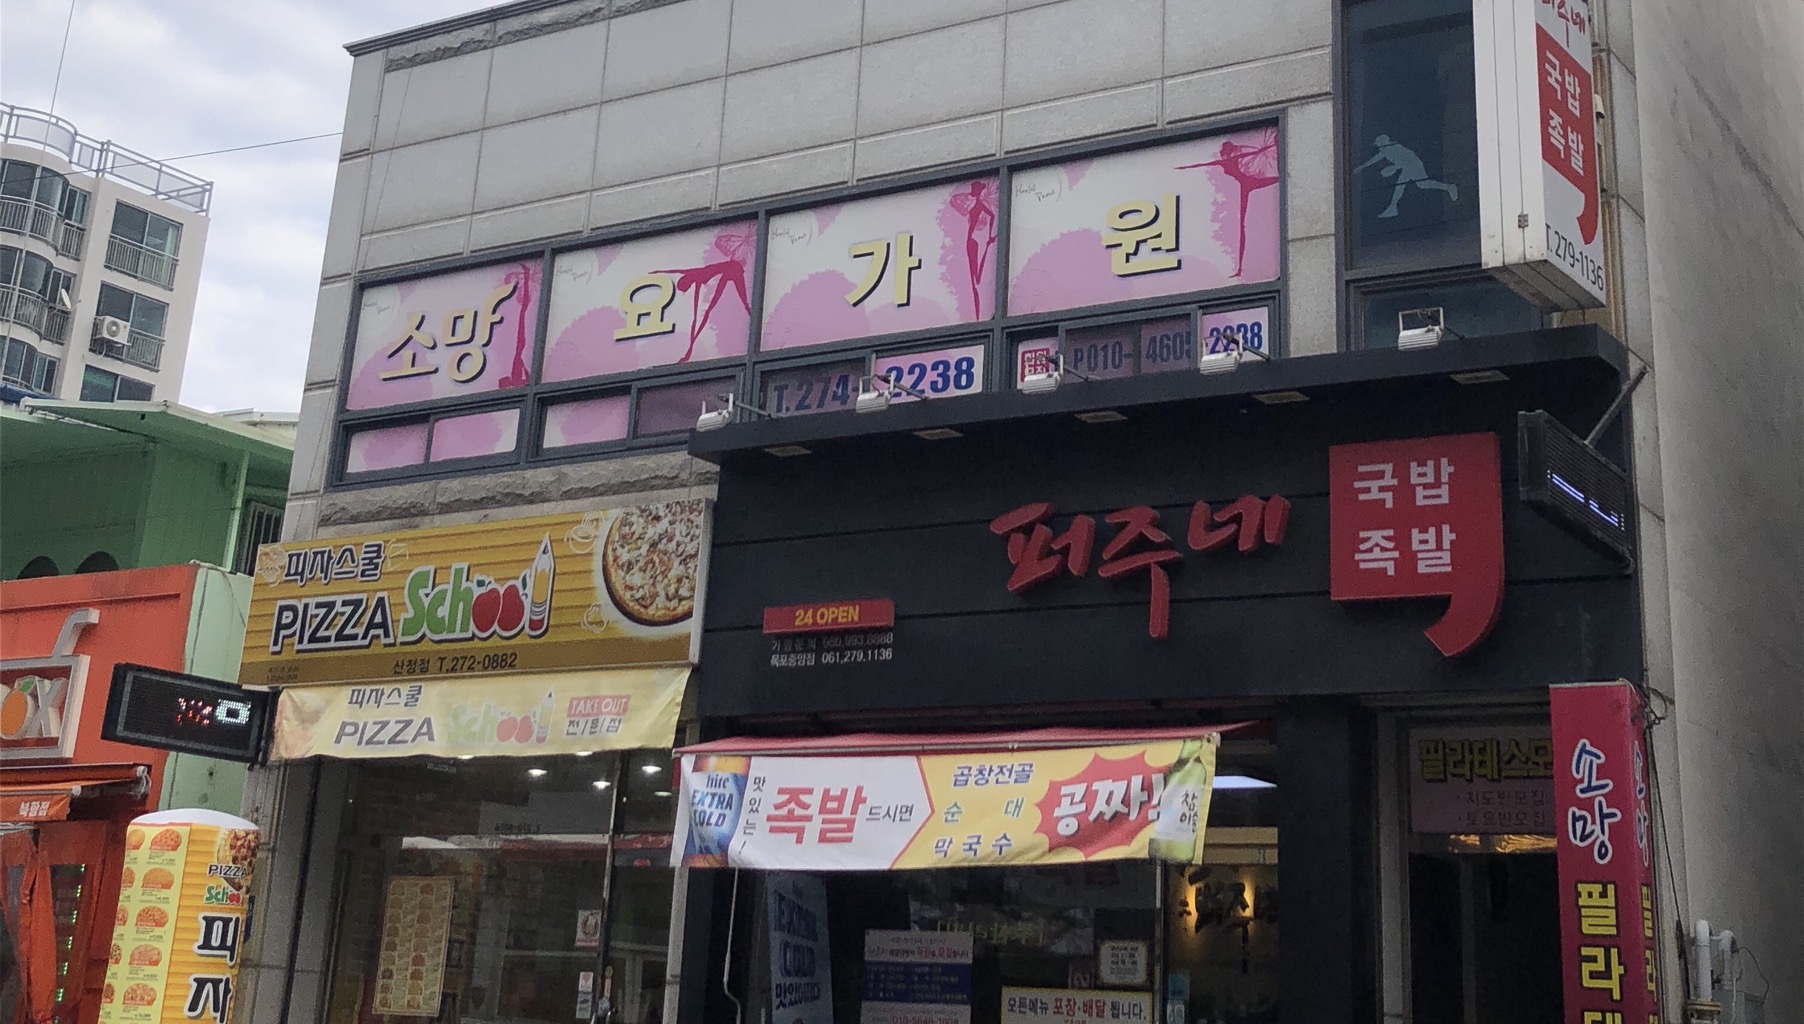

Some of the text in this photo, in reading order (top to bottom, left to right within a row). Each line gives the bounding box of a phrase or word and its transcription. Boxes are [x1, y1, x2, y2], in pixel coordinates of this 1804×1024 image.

[1545, 49, 1582, 117] 국밥
[1547, 108, 1584, 175] 족발
[1545, 222, 1604, 292] T.279-1136
[379, 192, 1183, 384] 소망 요 가 원
[1352, 456, 1456, 508] 국밥
[283, 541, 385, 586] 피자스쿨
[989, 493, 1292, 640] 퍼주네
[1353, 523, 1458, 576] 족발
[270, 534, 556, 655] PIZZA School
[794, 605, 860, 626] 24 OPEN
[392, 652, 519, 675] 산정점 T.272-0882
[333, 690, 556, 746] PIZZA School
[347, 684, 424, 710] 피자스쿨
[571, 697, 628, 715] TAKE OUT
[705, 773, 731, 789] hite
[952, 762, 1035, 788] 곱창전골
[1418, 737, 1554, 783] 필라테스모
[691, 790, 734, 811] EXTRA
[693, 810, 727, 828] COLD
[765, 784, 915, 846] 족발 드시면
[1053, 772, 1165, 838] 공짜!
[1568, 738, 1623, 865] 소망
[934, 833, 1013, 860] 막국수
[205, 885, 241, 904] Schoo
[184, 913, 241, 1024] 피자
[1576, 883, 1626, 1024] 필라
[1007, 997, 1050, 1016] 모든메뉴
